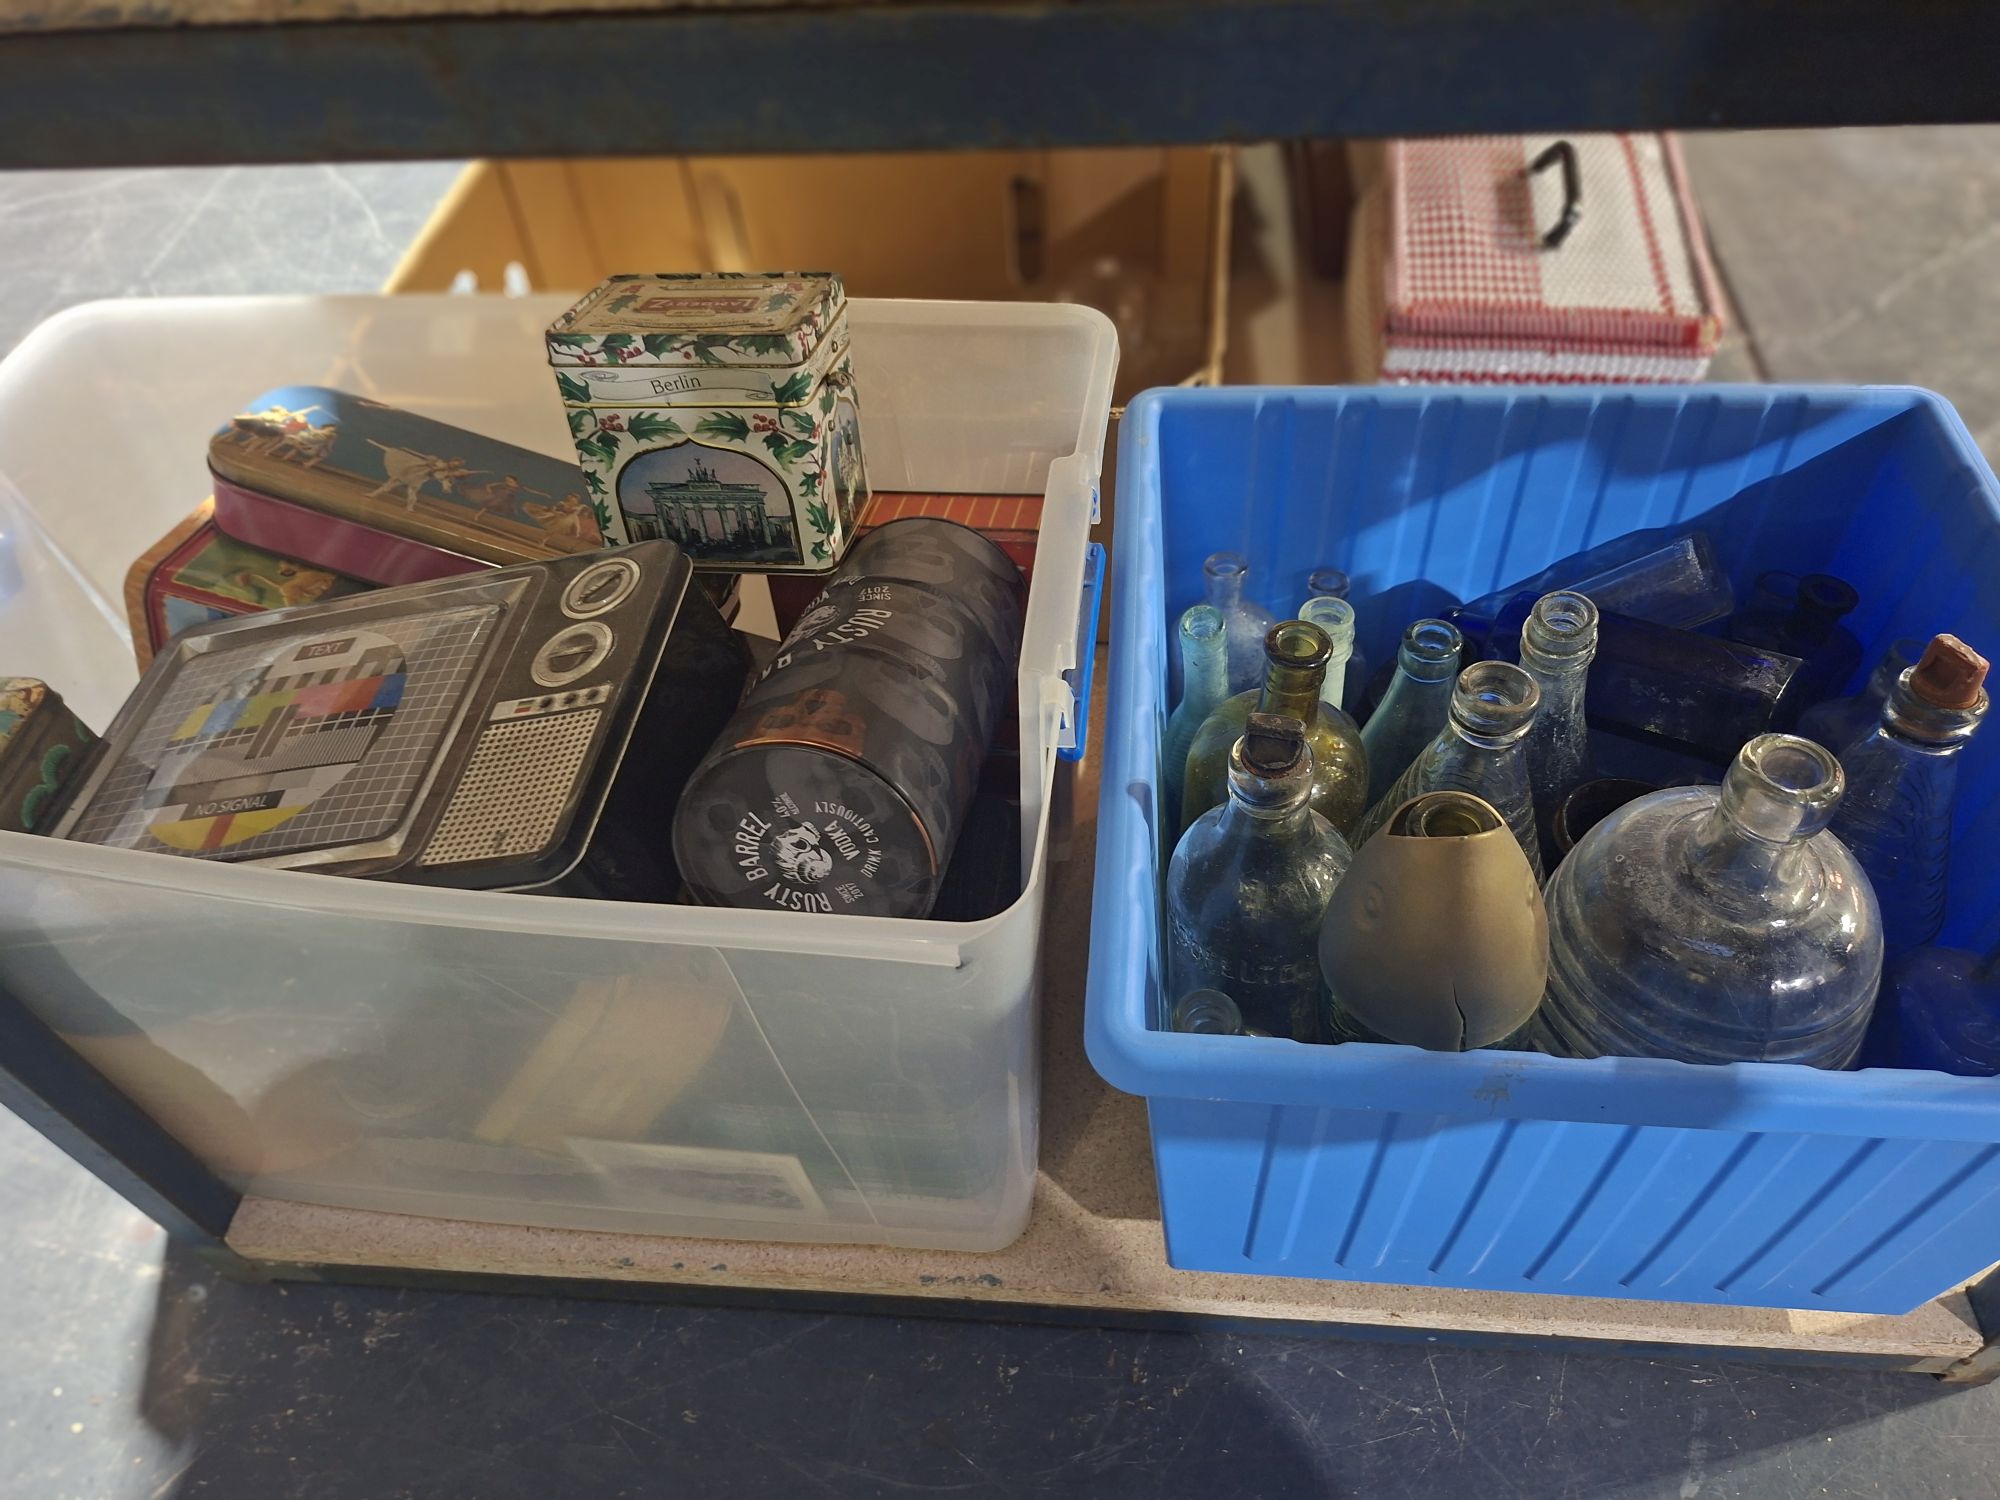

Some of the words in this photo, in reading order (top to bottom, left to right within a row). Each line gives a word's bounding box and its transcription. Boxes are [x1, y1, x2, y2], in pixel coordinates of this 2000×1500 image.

[650, 375, 702, 395] Berlin
[858, 593, 892, 602] SINCE
[860, 586, 890, 595] 2017
[812, 608, 893, 651] RUSTY
[307, 641, 345, 657] TEXT
[193, 802, 218, 817] NO
[217, 795, 268, 814] SIGNAL
[815, 801, 880, 843] CAUTIOUSLY
[735, 811, 772, 881] BARREL
[824, 820, 861, 861] VODKA
[860, 849, 882, 879] DRINK
[763, 882, 833, 913] RUSTY
[834, 884, 856, 904] SINCE
[845, 882, 865, 899] 2017
